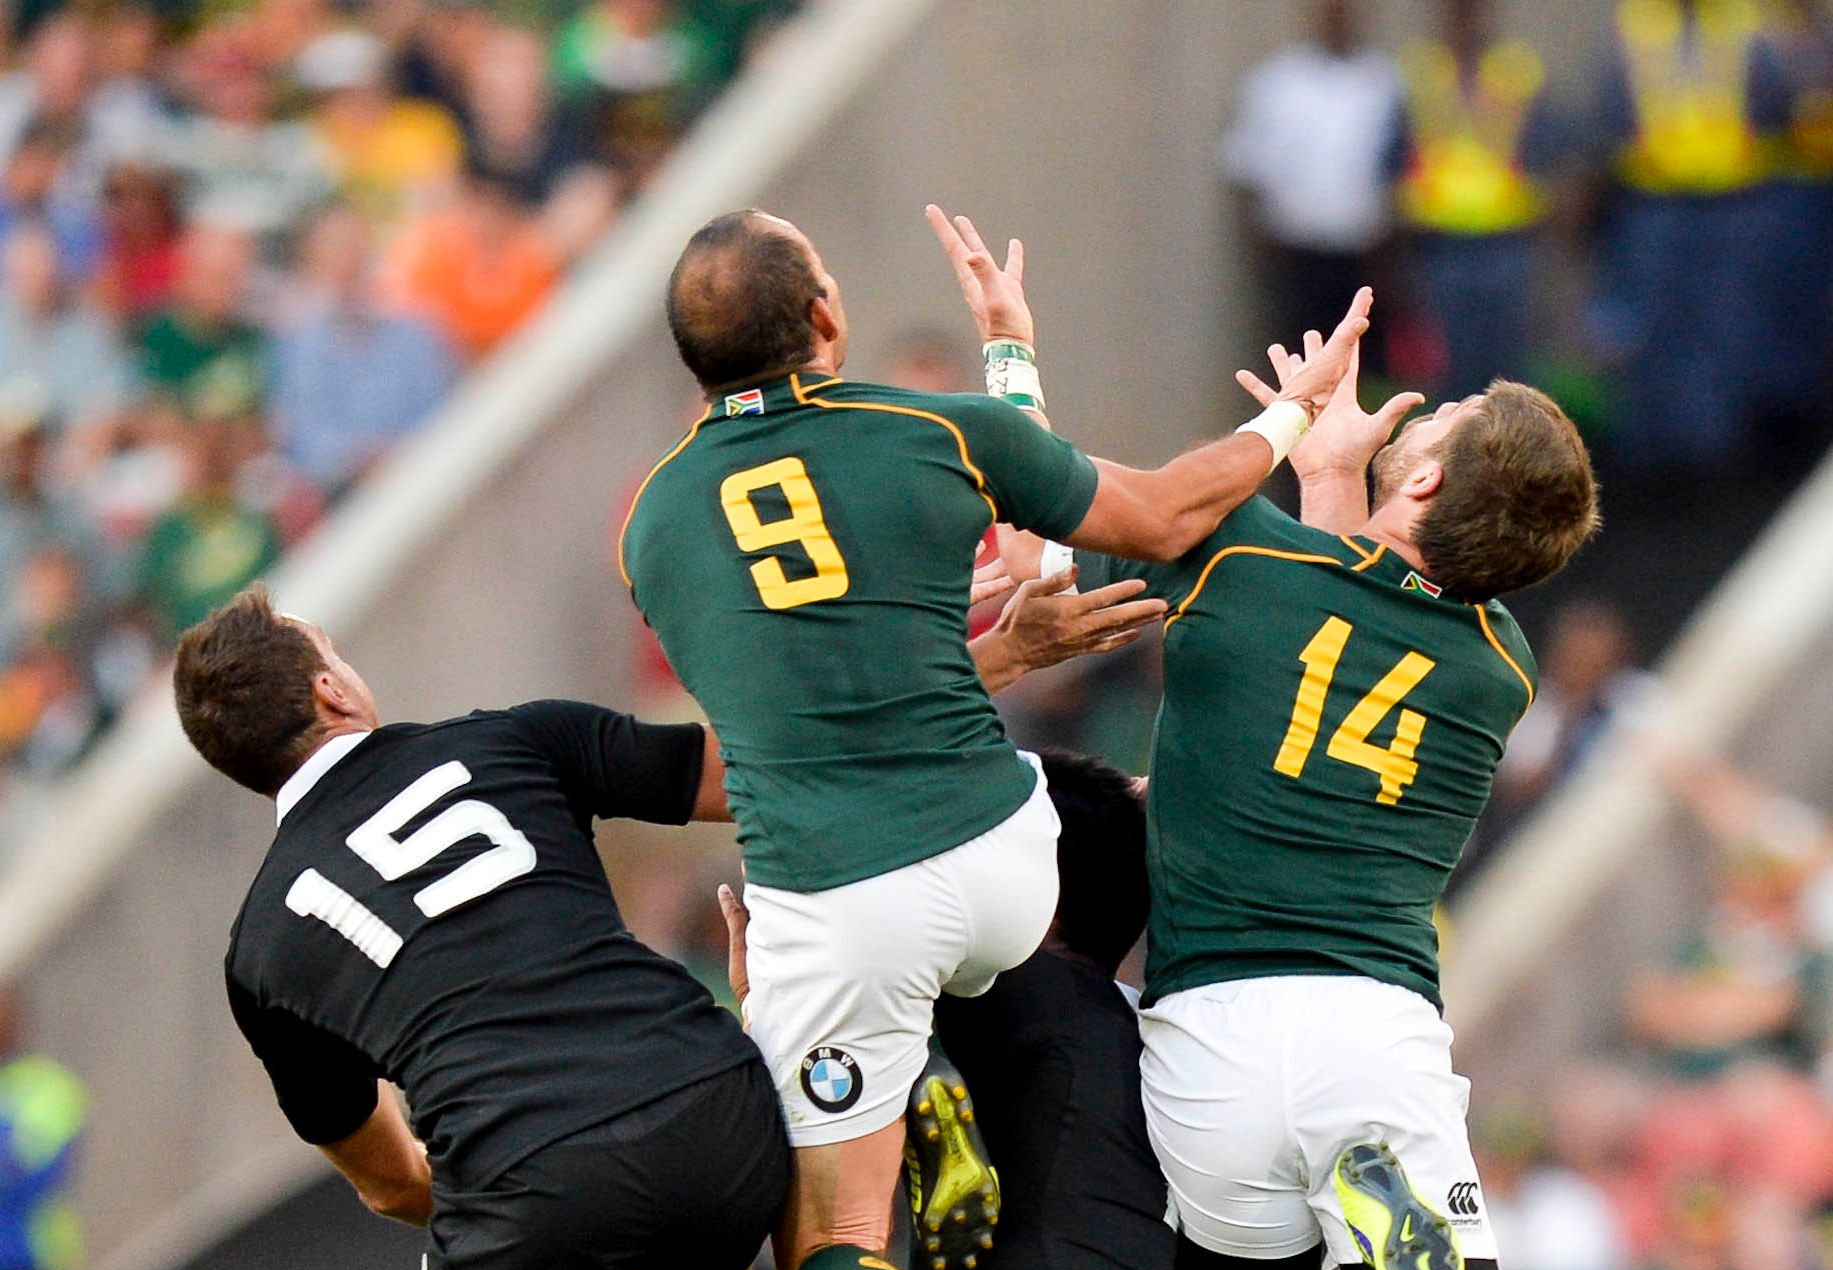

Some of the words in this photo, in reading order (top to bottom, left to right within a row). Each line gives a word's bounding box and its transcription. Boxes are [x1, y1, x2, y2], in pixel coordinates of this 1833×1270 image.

[720, 457, 849, 610] 9
[1273, 616, 1435, 805] 14
[285, 760, 537, 969] 15
[802, 1047, 855, 1071] BMW
